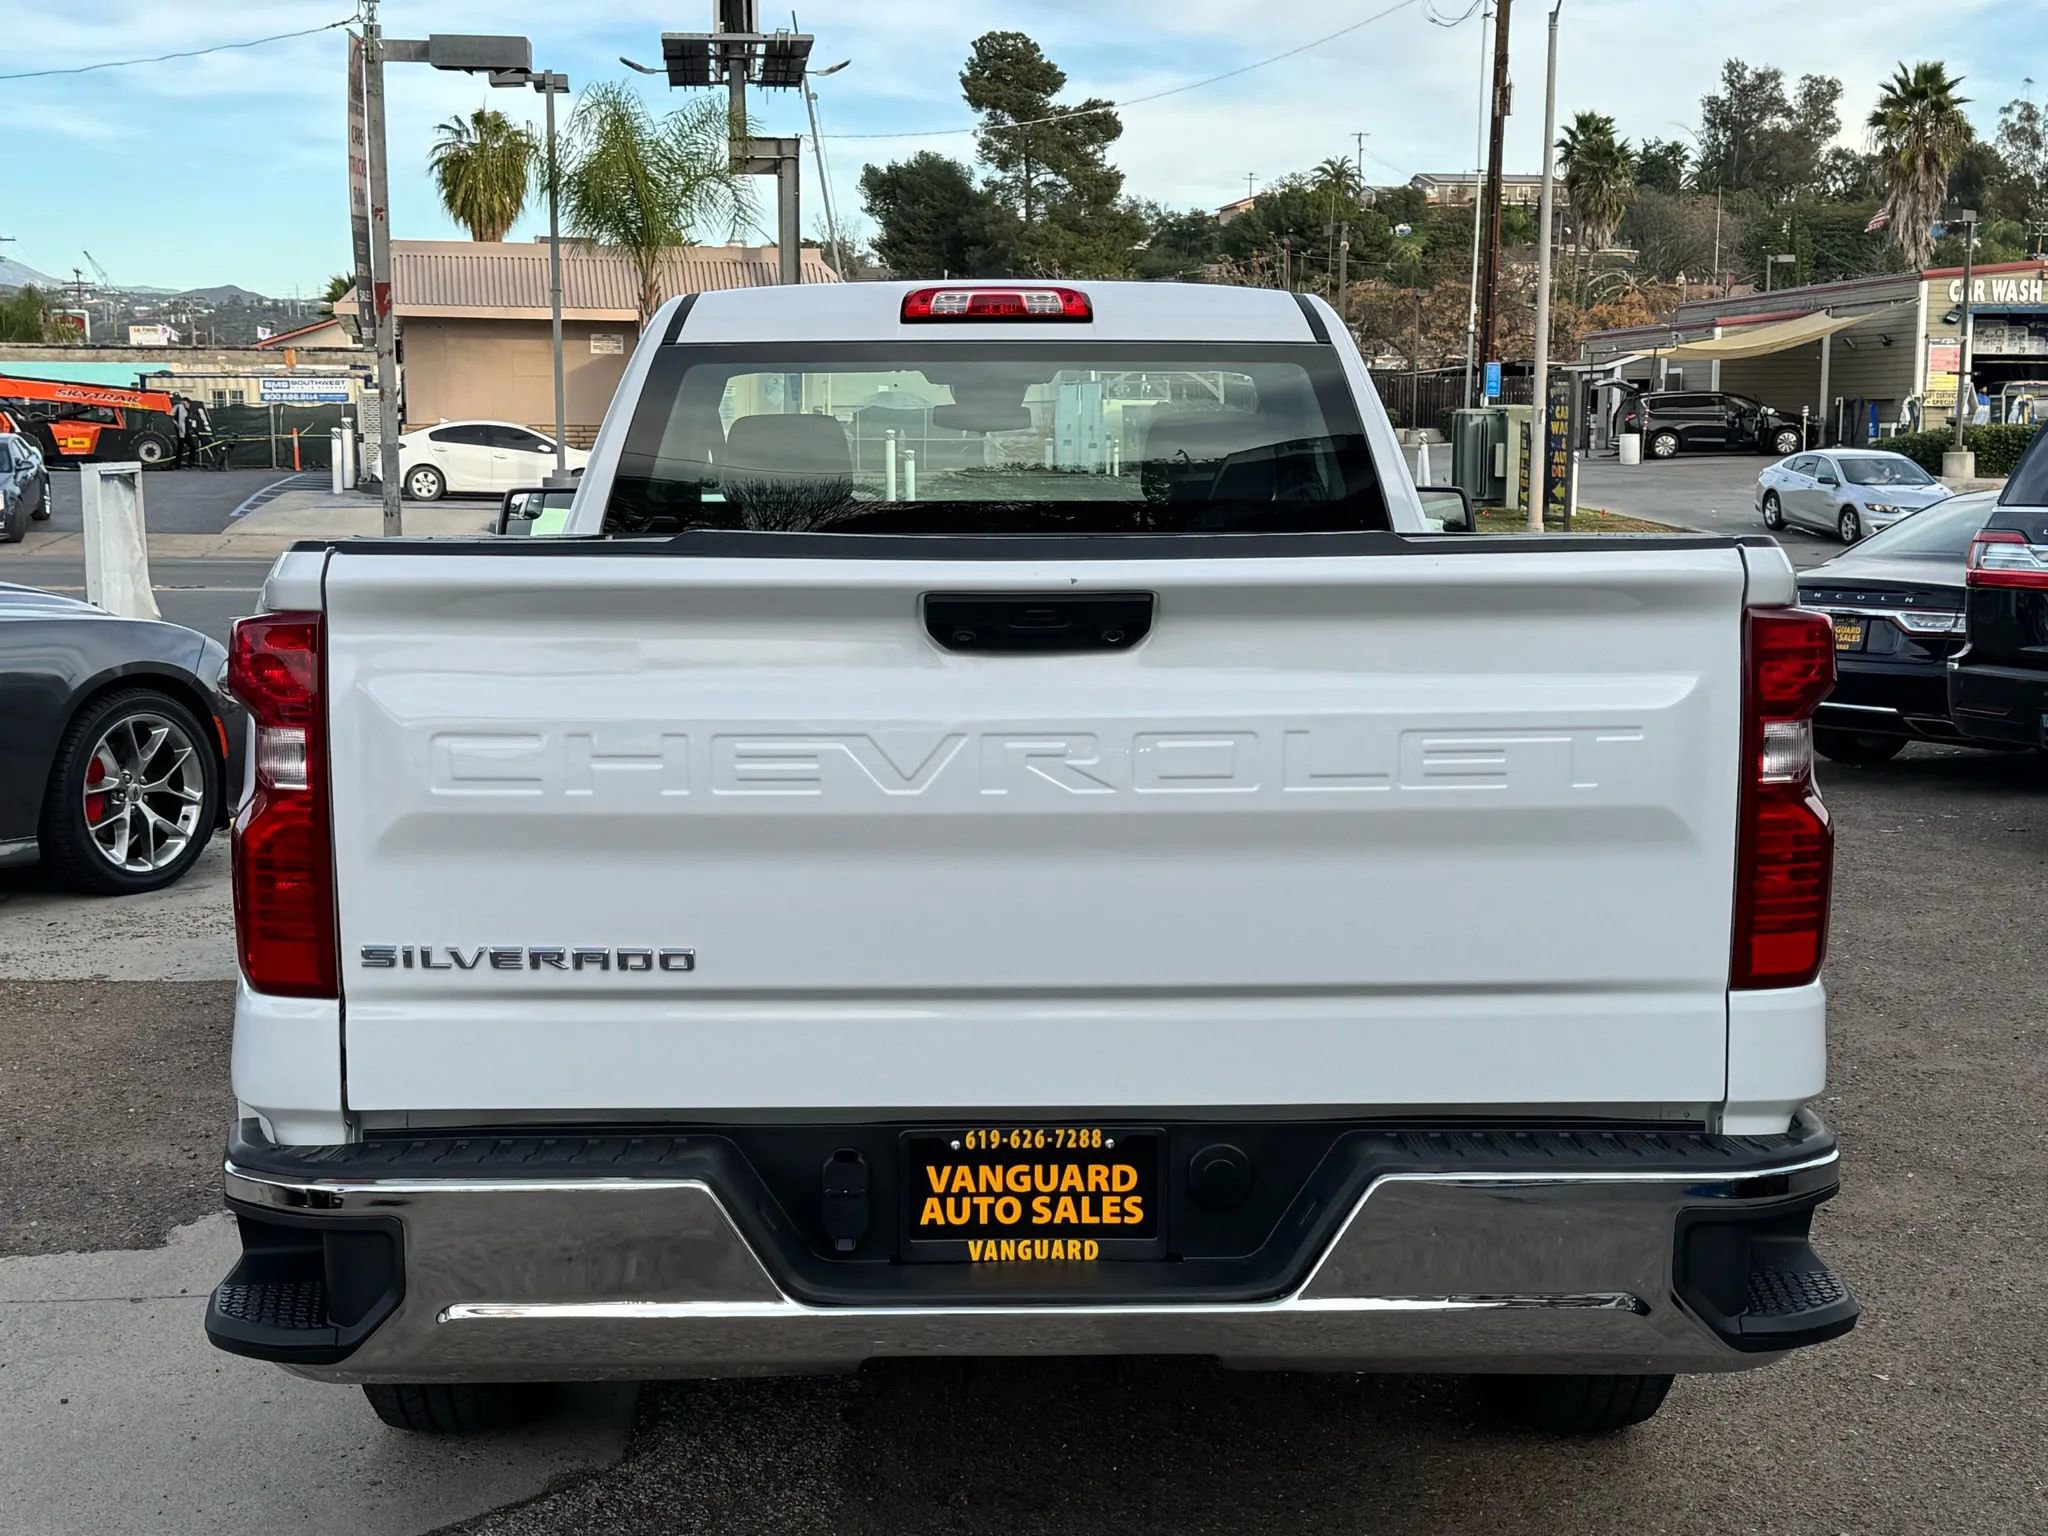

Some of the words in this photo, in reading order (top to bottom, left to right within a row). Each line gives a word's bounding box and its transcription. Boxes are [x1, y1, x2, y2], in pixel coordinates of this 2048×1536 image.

[1949, 279, 1985, 302] CAR
[1991, 279, 2043, 302] WASH
[57, 388, 140, 402] SKYTRAK
[1814, 592, 1914, 603] NCOLN
[1835, 626, 1861, 634] GUARD
[1838, 634, 1861, 642] SALES
[428, 725, 1645, 797] CHEVROLET
[361, 944, 696, 970] SILVERADO
[965, 1129, 1102, 1149] 619-626-7288
[926, 1164, 1138, 1193] VANGUARD
[920, 1196, 1022, 1225] AUTO
[1032, 1196, 1144, 1224] SALES
[968, 1240, 1099, 1261] VANGUARD
